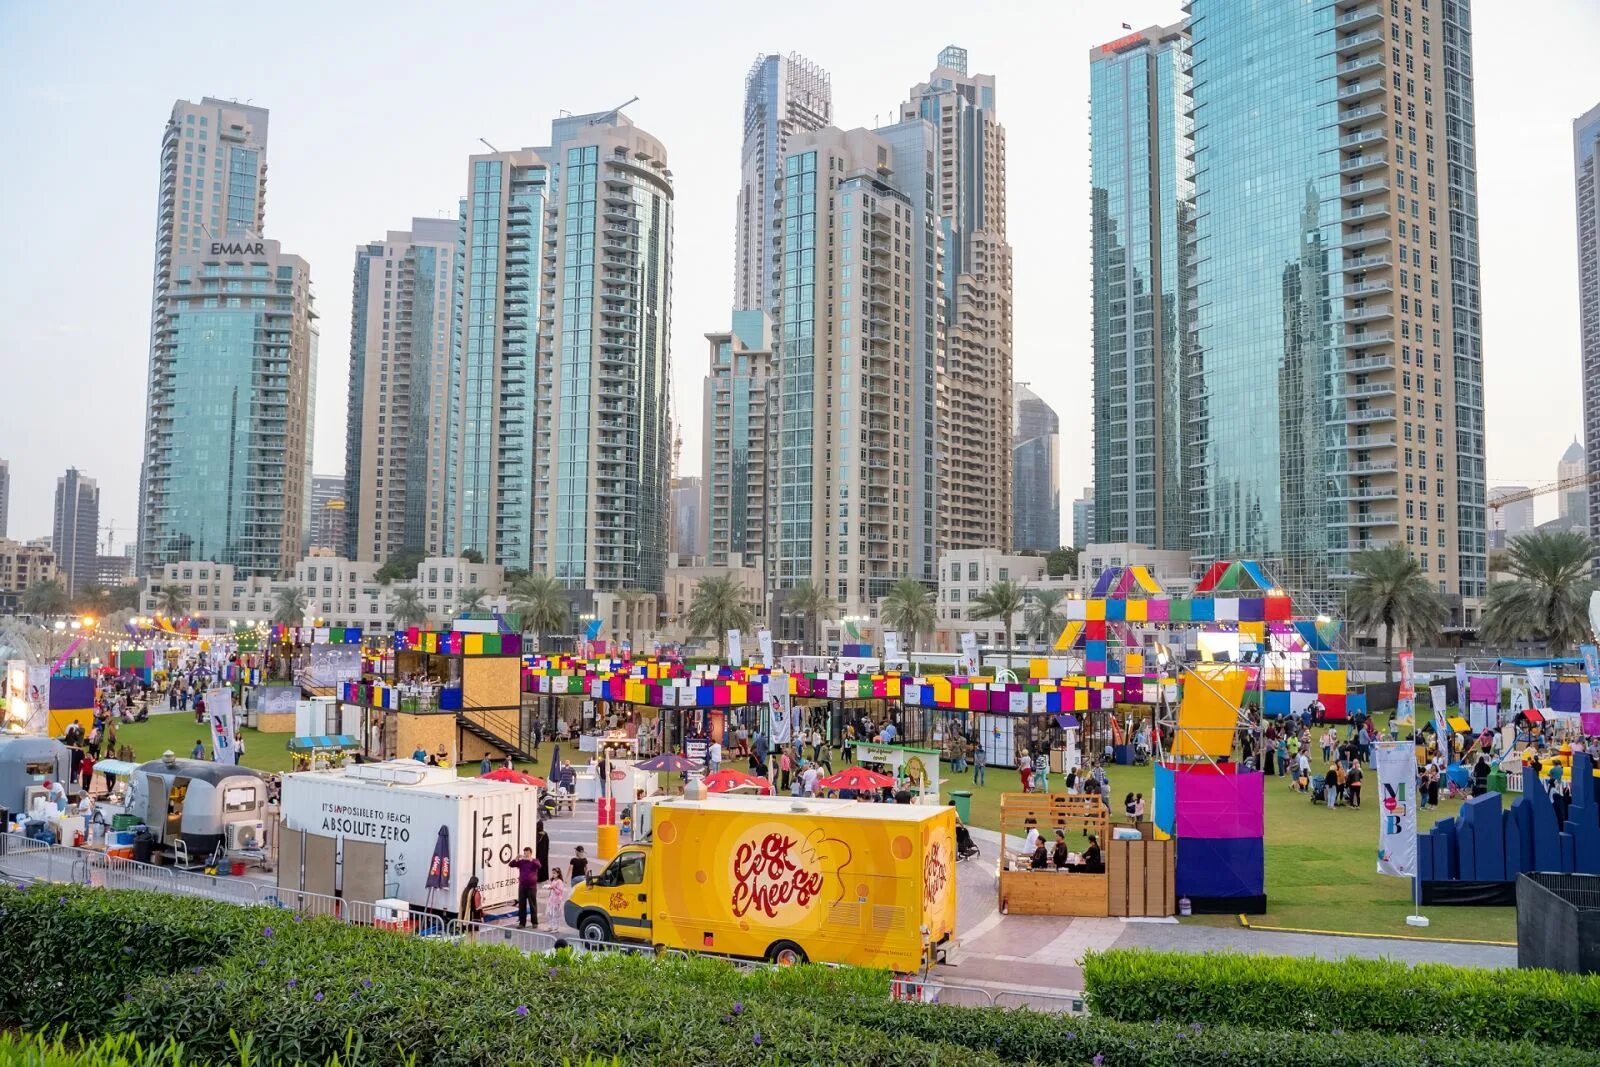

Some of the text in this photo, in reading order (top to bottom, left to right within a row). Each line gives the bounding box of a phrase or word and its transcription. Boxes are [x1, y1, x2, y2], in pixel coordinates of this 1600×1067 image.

[211, 243, 264, 255] EMAAR
[374, 810, 384, 820] TO
[386, 812, 411, 824] REACH
[322, 817, 410, 843] ABSOLUTE ZERO
